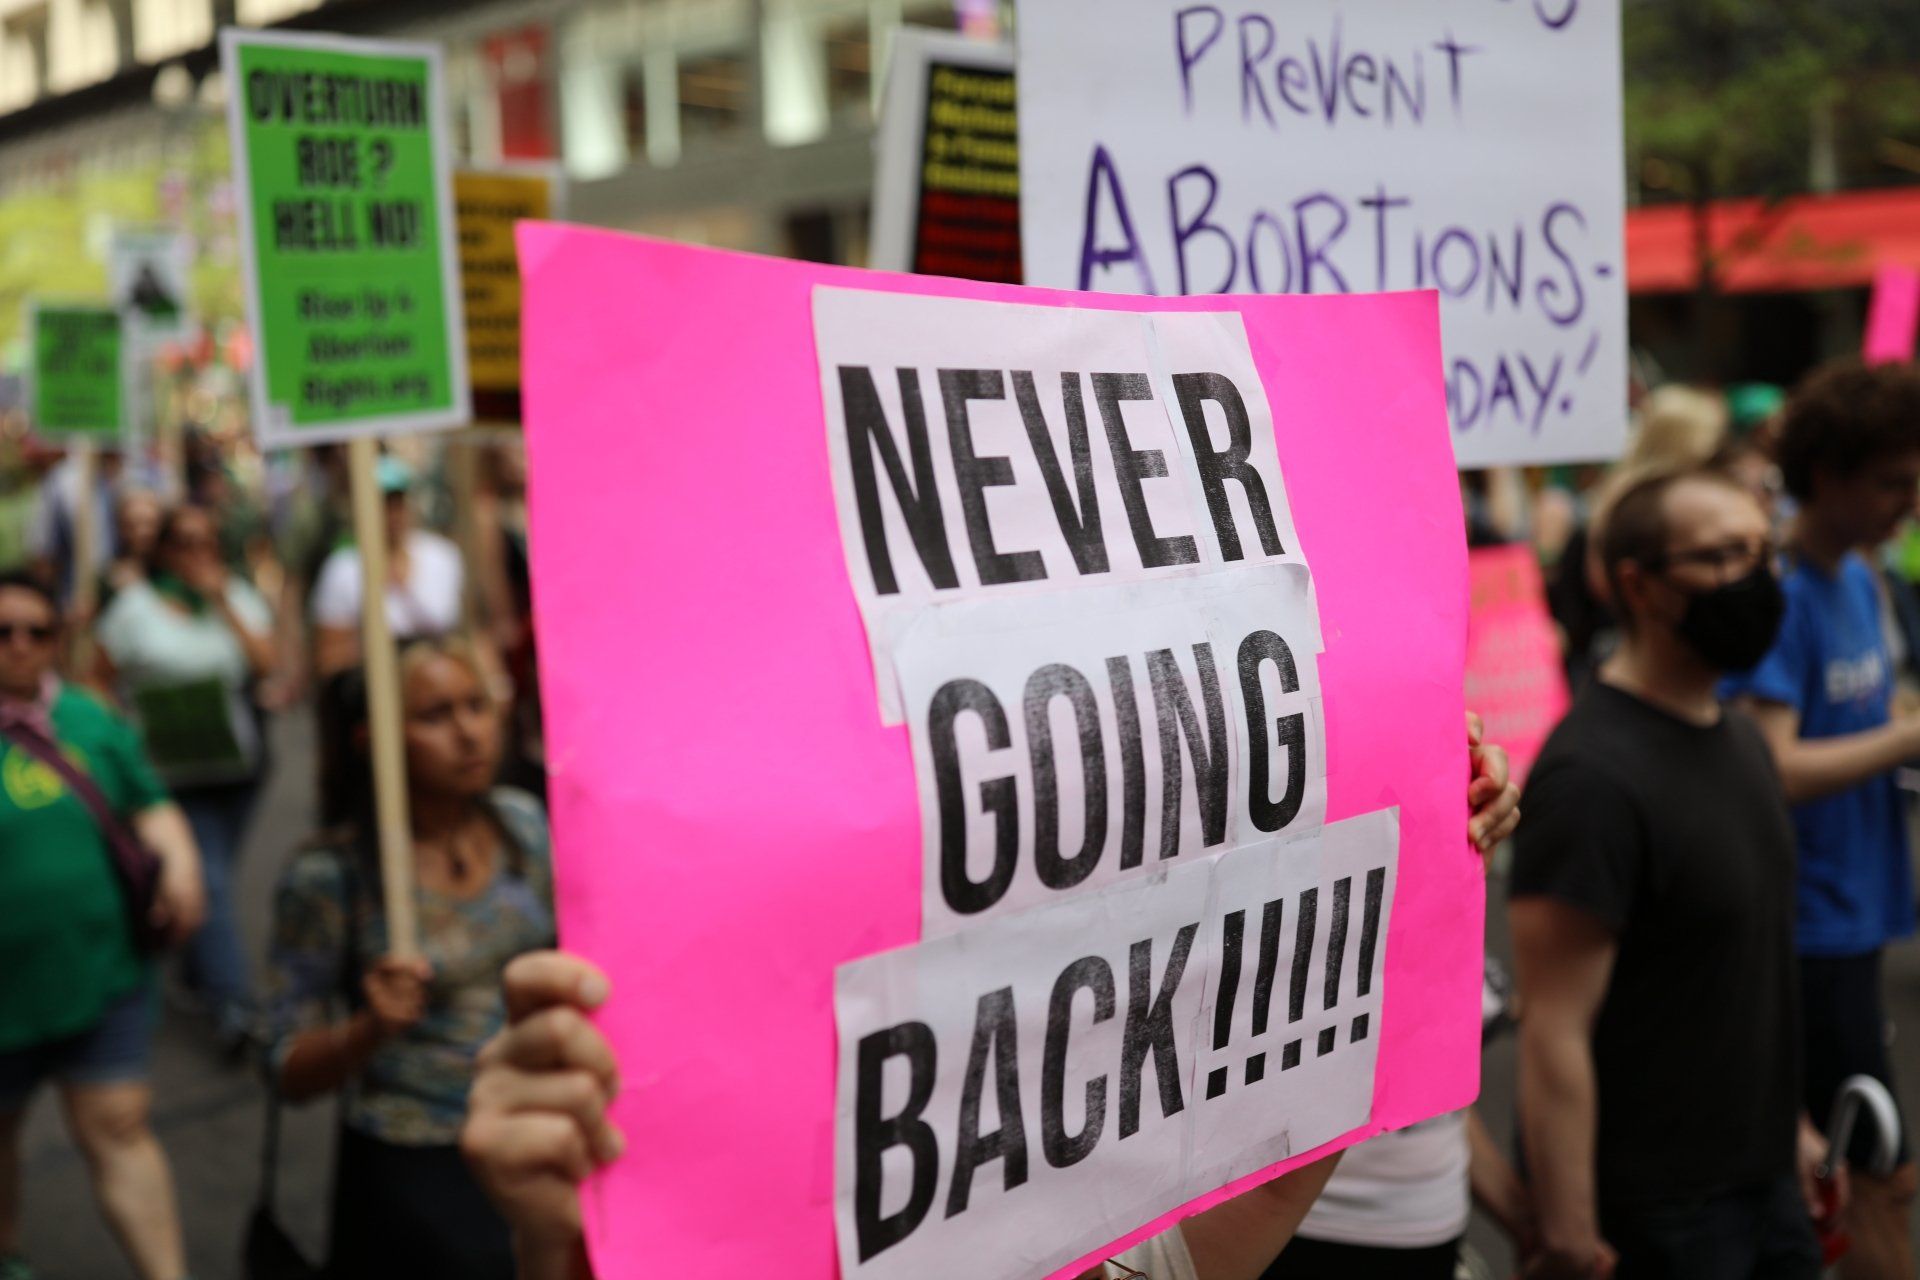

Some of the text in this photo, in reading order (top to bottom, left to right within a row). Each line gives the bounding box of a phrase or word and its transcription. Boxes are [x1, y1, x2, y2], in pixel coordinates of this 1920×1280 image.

[248, 69, 425, 129] OVERTURN
[274, 199, 357, 250] HELL
[836, 364, 1286, 596] NEVER
[927, 629, 1306, 916] GOING
